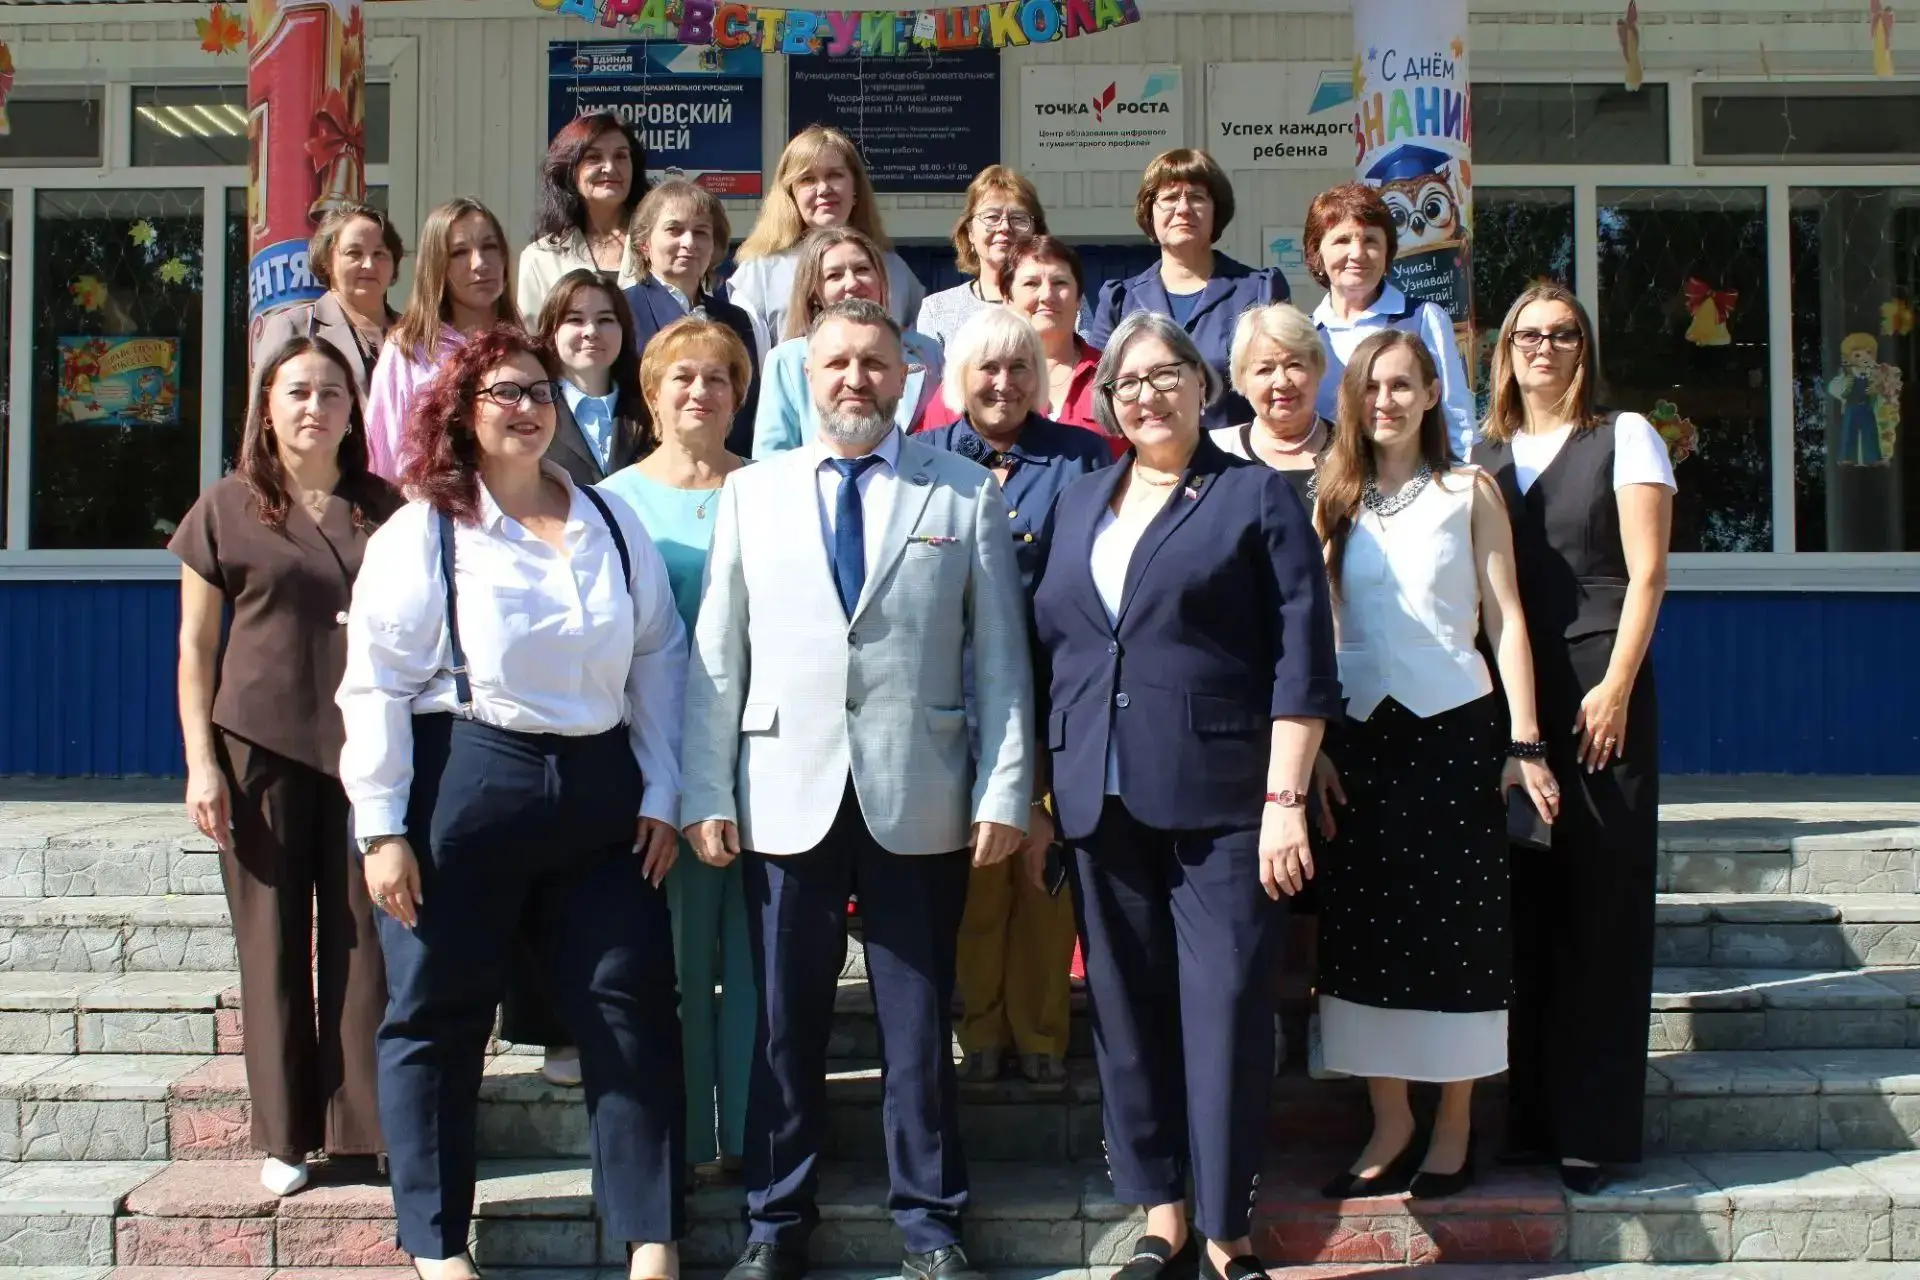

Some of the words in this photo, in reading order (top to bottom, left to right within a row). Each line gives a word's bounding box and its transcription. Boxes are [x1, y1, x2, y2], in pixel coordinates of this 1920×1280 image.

[593, 56, 633, 64] ЕДИНАЯ
[1382, 49, 1397, 81] С
[593, 64, 633, 72] РОССИЯ
[930, 94, 962, 102] имени
[578, 98, 732, 124] УОРОВСКИЙ
[1035, 103, 1089, 115] ТОЧКА
[1116, 102, 1170, 114] РОСТА
[1221, 122, 1273, 136] Успех
[1353, 81, 1471, 167] ЗНАНИЙ
[634, 123, 691, 152] ИЦЕЙ
[1039, 130, 1064, 138] Центр
[1065, 129, 1119, 138] образования
[1120, 129, 1167, 138] цифрового
[1046, 140, 1106, 148] гуманитарного
[1108, 140, 1151, 148] профилей
[1253, 143, 1328, 160] ребенка
[1393, 256, 1437, 279] Учись!
[1401, 270, 1454, 293] Узнавай!
